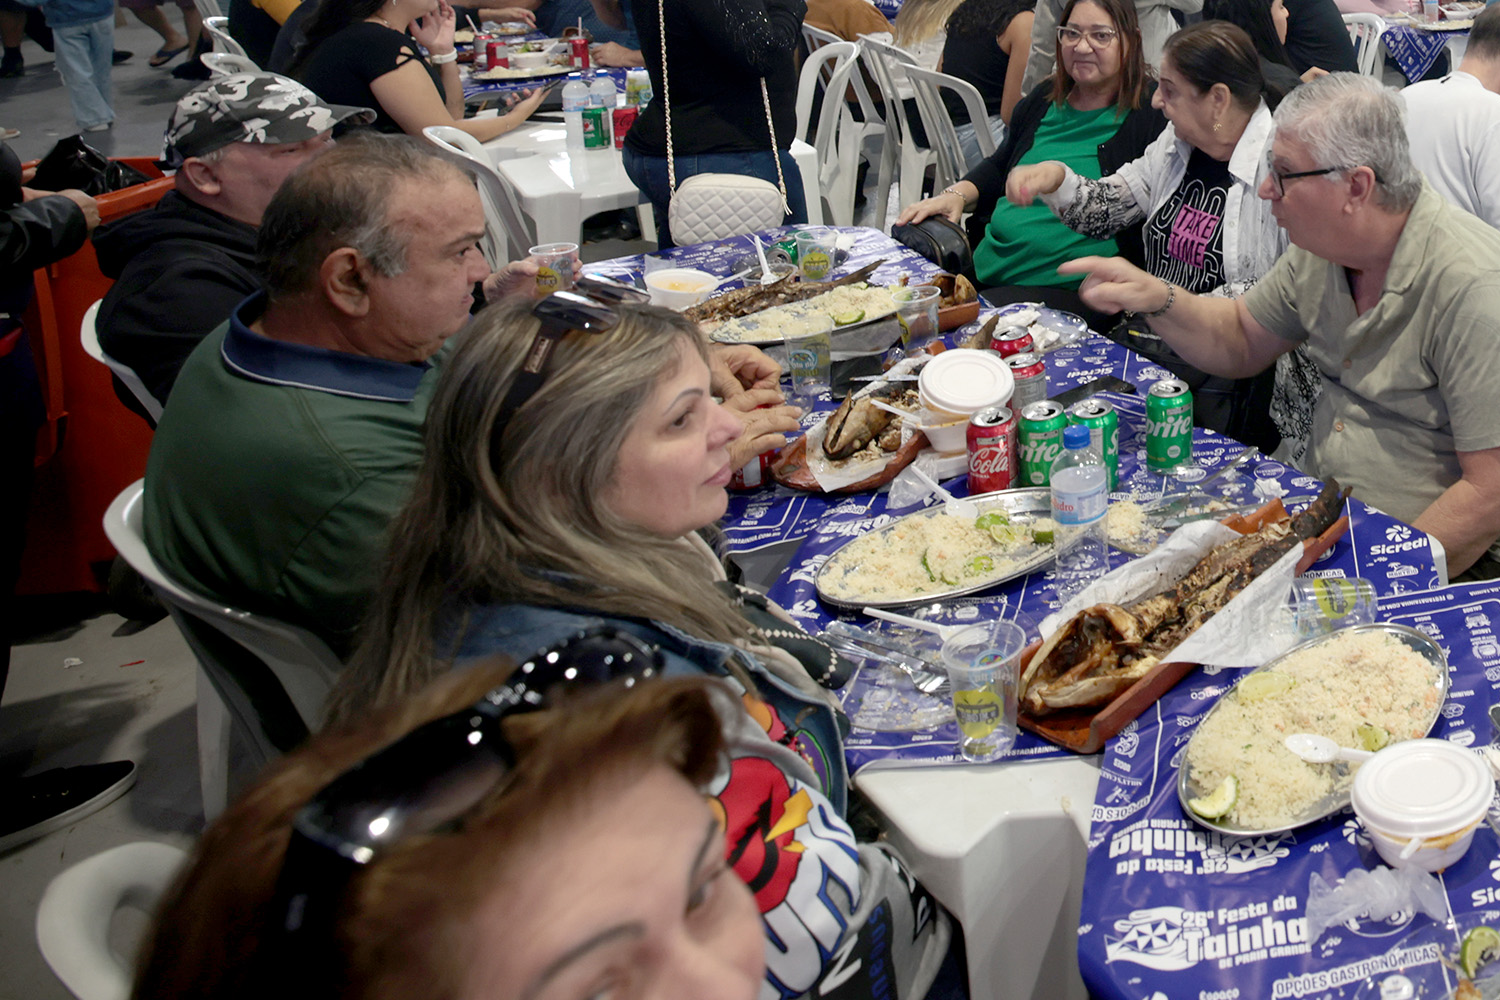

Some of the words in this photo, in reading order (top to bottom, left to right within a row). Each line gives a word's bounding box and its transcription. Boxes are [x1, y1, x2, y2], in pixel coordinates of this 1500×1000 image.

[1177, 207, 1218, 239] TAKE
[1170, 231, 1205, 267] TIME
[1066, 366, 1114, 380] Sicredi
[1370, 537, 1428, 556] Sicredi
[1116, 859, 1141, 875] da
[1145, 859, 1193, 875] Festa
[1218, 903, 1267, 925] Festa
[1273, 895, 1297, 911] da
[1184, 917, 1311, 961] Tainha
[1219, 958, 1233, 970] DE
[1235, 951, 1267, 966] PRAIA
[1276, 972, 1334, 998] OPÇÕES
[1335, 945, 1439, 984] GASTRONÔMICAS
